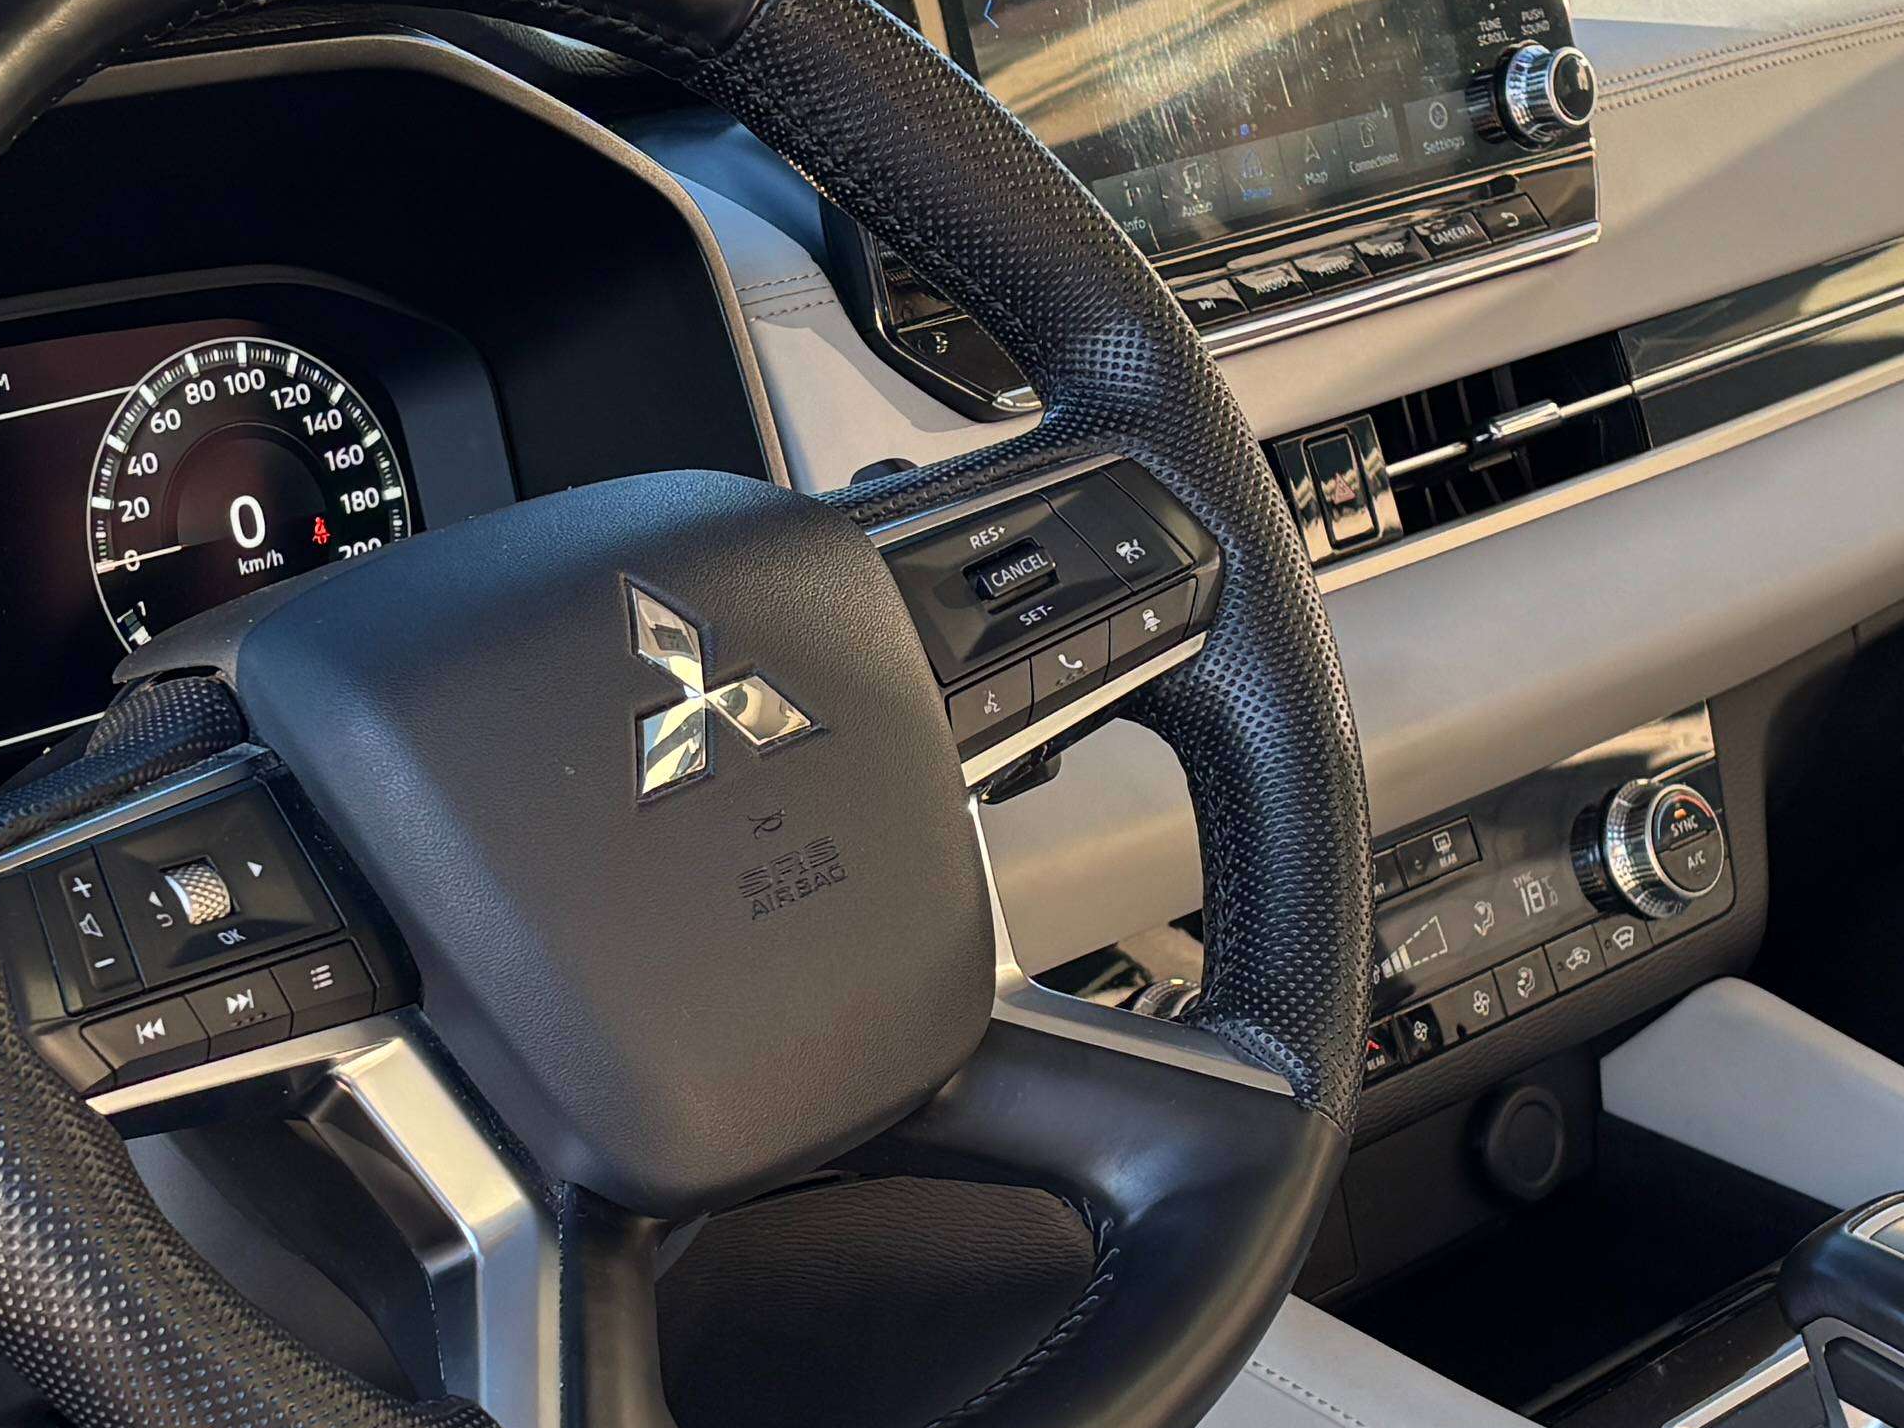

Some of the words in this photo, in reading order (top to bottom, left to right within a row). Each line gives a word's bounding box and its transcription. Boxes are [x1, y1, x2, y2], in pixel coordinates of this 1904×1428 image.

[1521, 7, 1546, 23] PUSH
[1422, 135, 1466, 156] Settings
[1304, 170, 1329, 186] Map
[1429, 223, 1476, 246] CAMERA
[184, 379, 217, 406] 80
[223, 369, 267, 396] 100
[269, 383, 312, 411] 120
[149, 408, 182, 435] 60
[302, 408, 343, 437] 140
[126, 451, 159, 478] 40
[323, 444, 365, 472] 160
[118, 496, 151, 523] 20
[339, 486, 381, 516] 180
[229, 494, 267, 549] 0
[969, 525, 1008, 550] RES+
[237, 549, 285, 576] km/h
[990, 552, 1049, 588] CANCEL
[1670, 814, 1699, 838] SYNC
[1687, 849, 1707, 871] A/C
[748, 864, 848, 921] AIRBAG
[217, 927, 247, 946] OK
